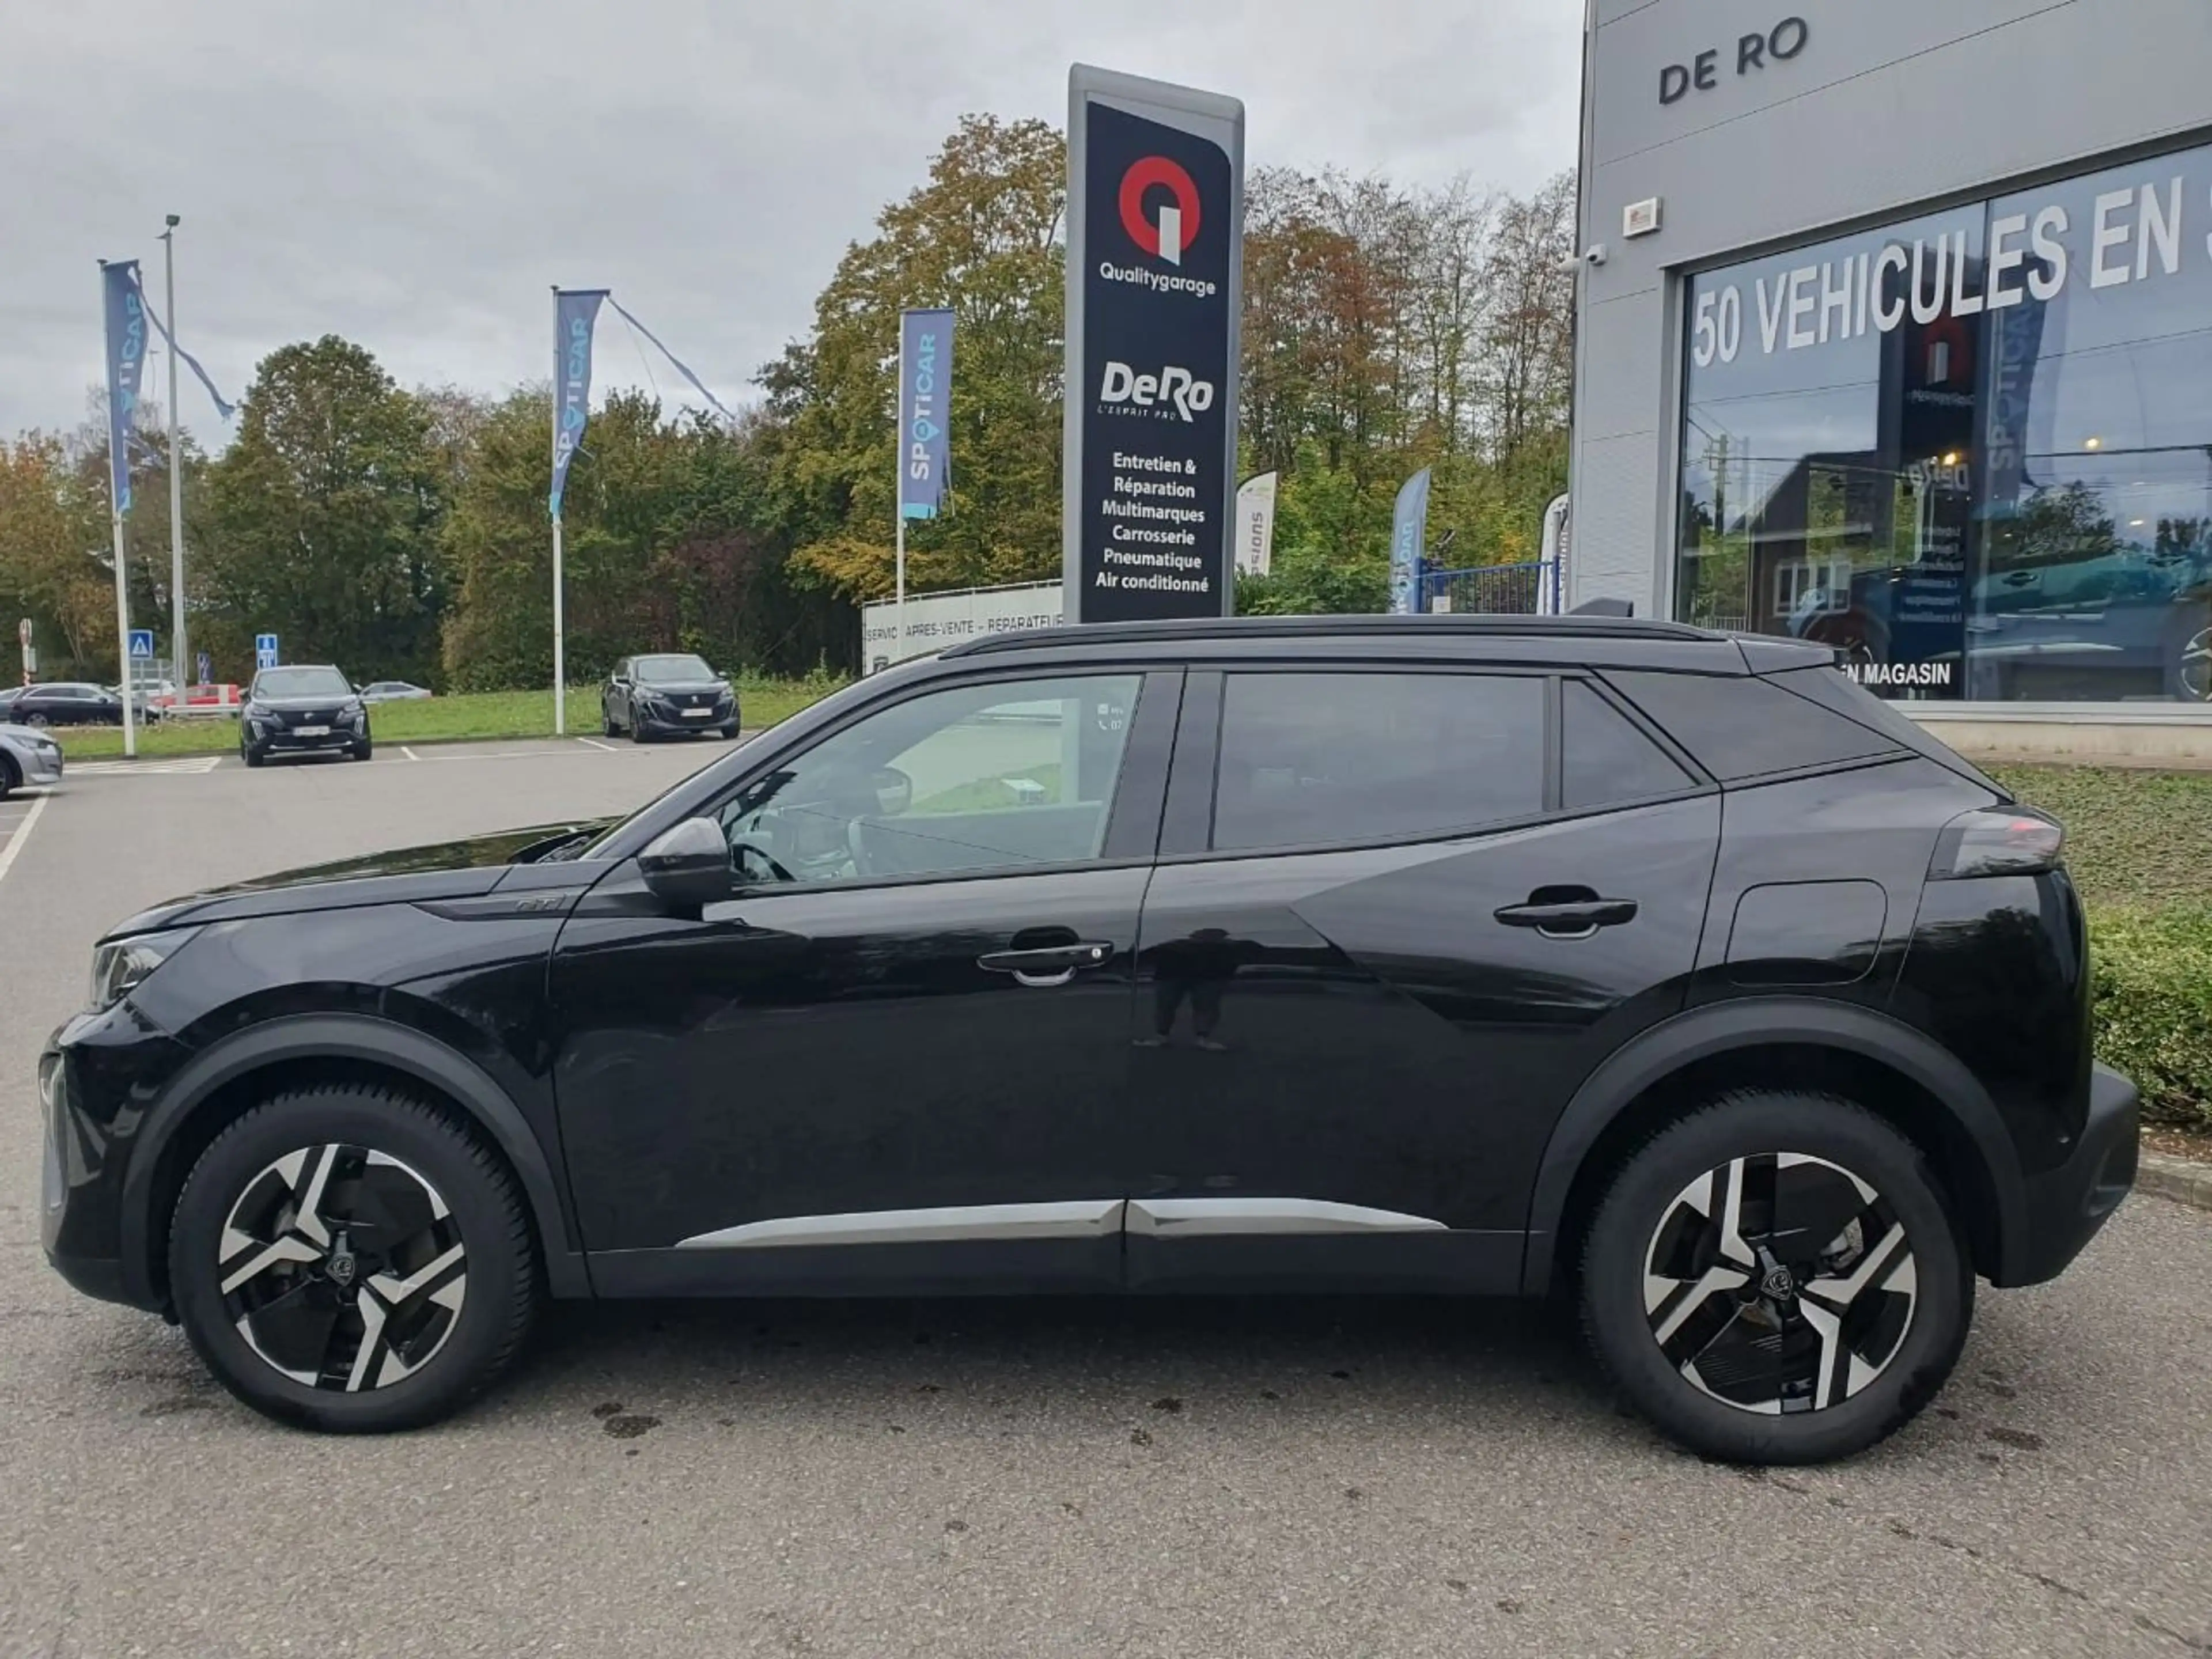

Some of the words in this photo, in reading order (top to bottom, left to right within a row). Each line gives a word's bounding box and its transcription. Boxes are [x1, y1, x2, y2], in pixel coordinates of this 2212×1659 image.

[1658, 48, 1718, 105] DE
[1736, 16, 1808, 75] RO
[1100, 262, 1216, 298] Qualitygarage
[1694, 285, 1741, 368] 50
[1756, 206, 2069, 354] VEHICULES
[2091, 176, 2182, 289] EN
[1100, 361, 1214, 423] DeRo
[1112, 451, 1182, 474] Entretien
[1184, 459, 1197, 475] &
[1113, 476, 1196, 498] Réparation
[1101, 499, 1206, 525] Multimarques
[1112, 524, 1195, 545] Carrosserie
[1103, 547, 1202, 571] Pneumatique
[1095, 571, 1119, 588] Air
[1121, 573, 1210, 592] conditionné
[1864, 662, 1950, 684] MAGASIN
